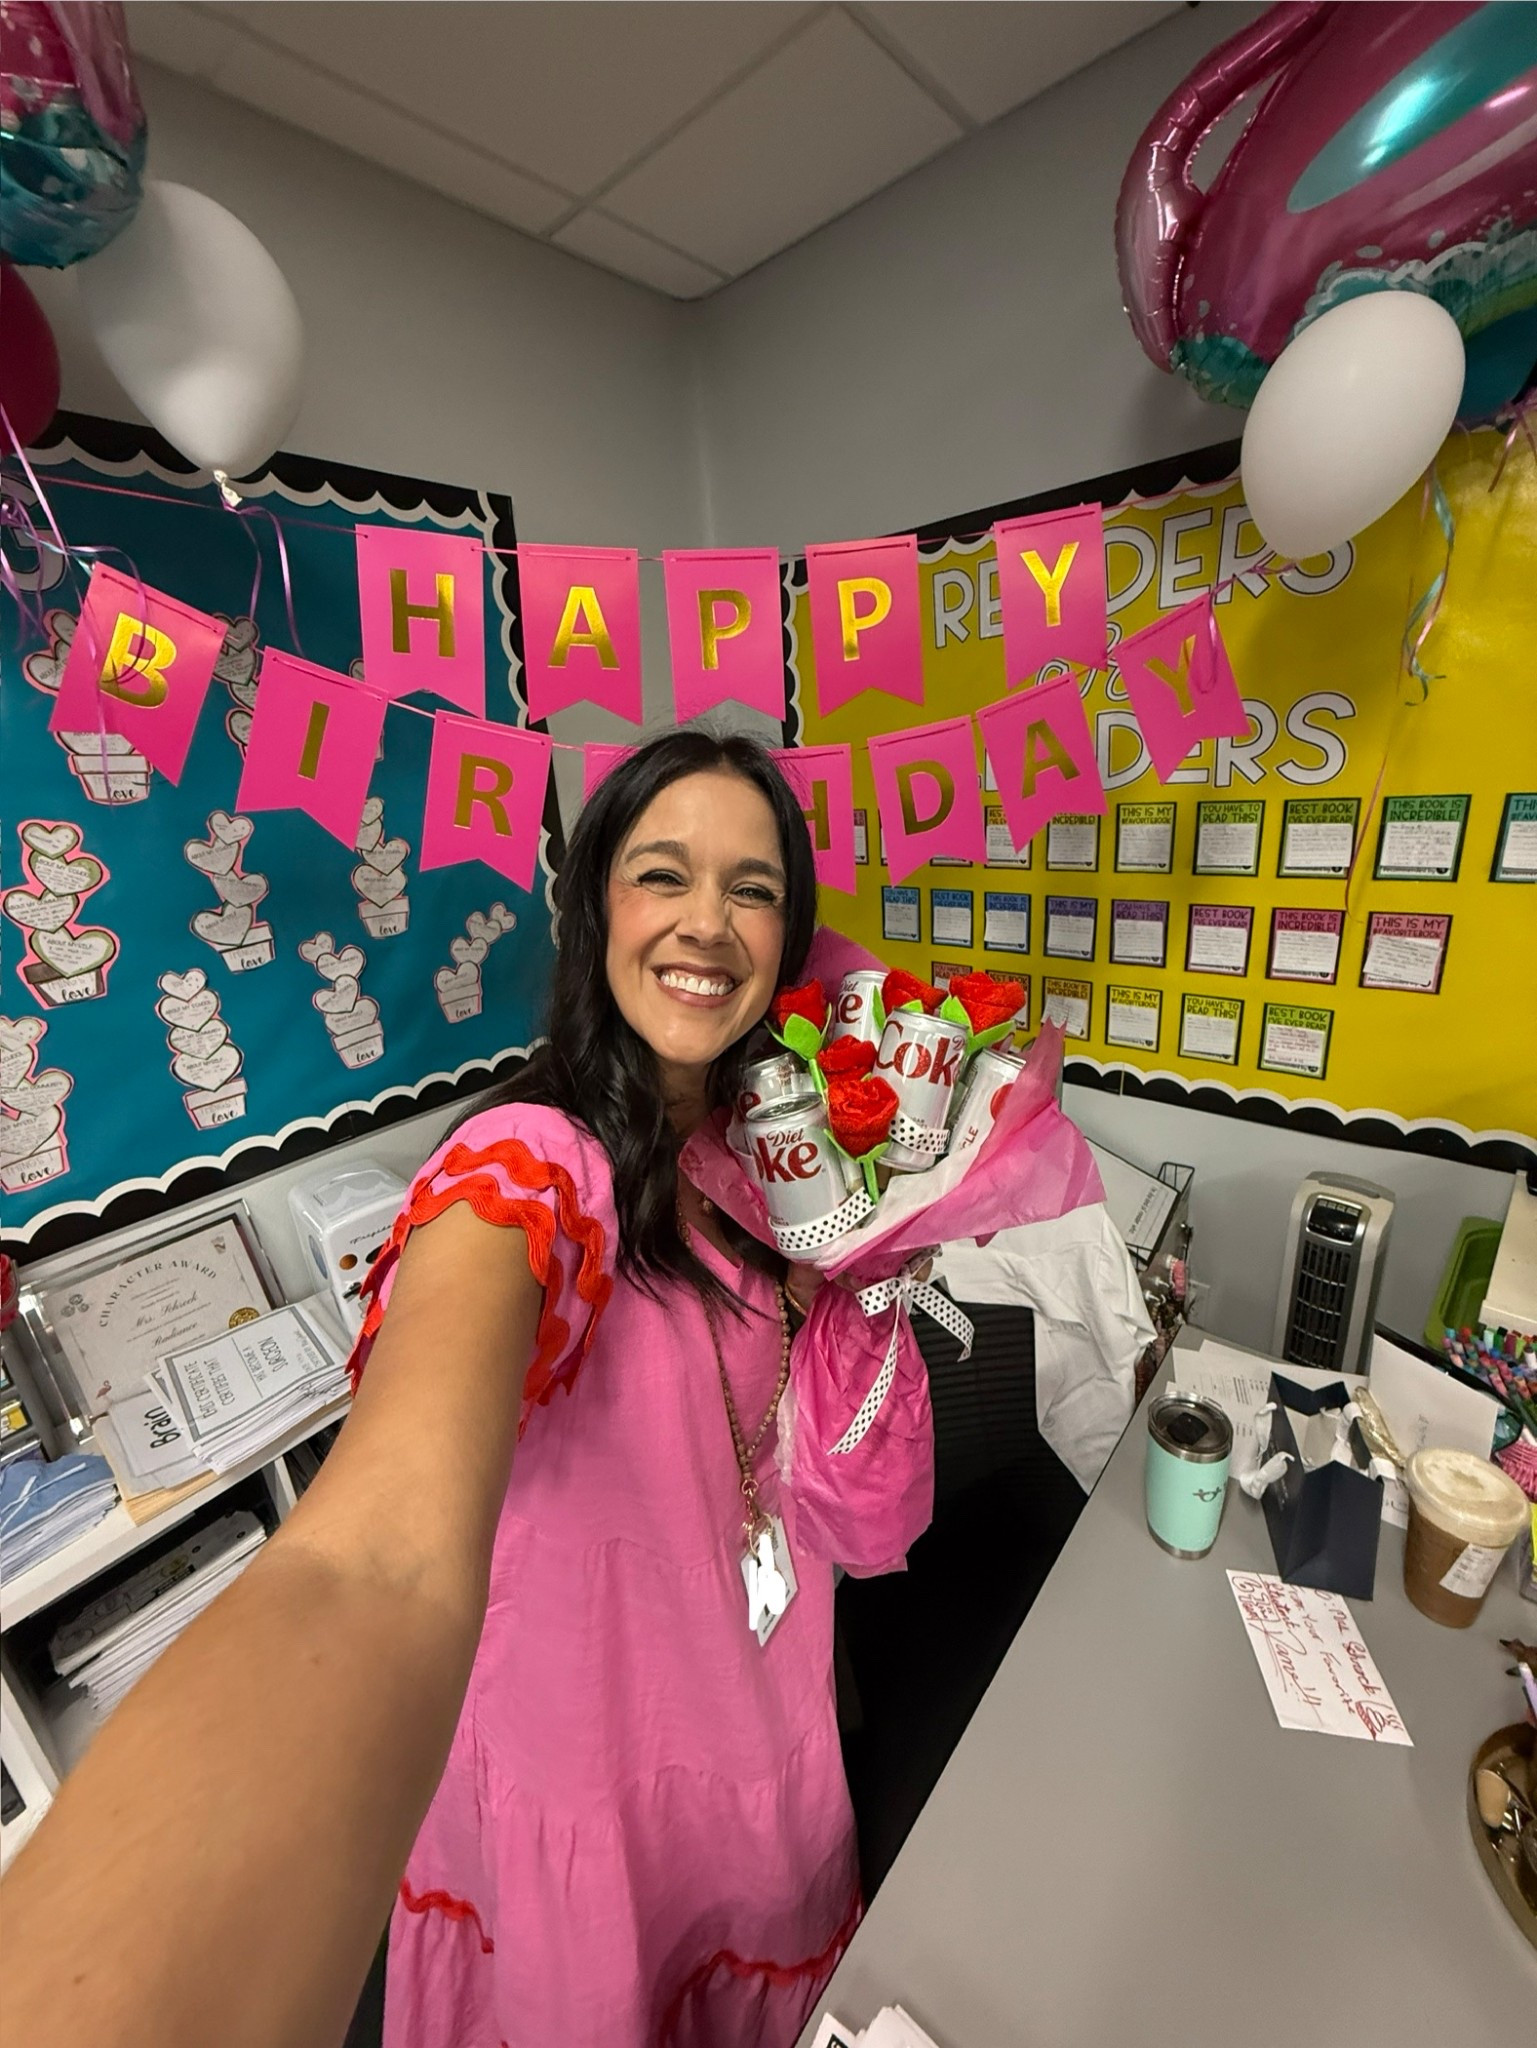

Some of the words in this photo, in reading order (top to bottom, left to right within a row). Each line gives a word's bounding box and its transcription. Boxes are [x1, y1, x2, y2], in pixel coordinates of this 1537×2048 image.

[389, 541, 1080, 671] HAPPY
[97, 612, 1197, 851] BIRHDAY
[1202, 804, 1222, 813] YOU
[1224, 804, 1244, 813] HAVE
[1246, 803, 1260, 812] TO
[1289, 804, 1318, 814] BEST
[1322, 803, 1354, 814] BOOK
[1392, 800, 1415, 809] THIS
[1418, 799, 1450, 809] BOOK
[1451, 799, 1463, 809] IS
[1122, 807, 1142, 817] THIS
[1145, 807, 1153, 816] IS
[1158, 807, 1172, 816] MY
[1202, 813, 1228, 823] READ
[1231, 812, 1258, 823] THIS!
[1390, 809, 1461, 821] INCREDIBLE!
[1194, 908, 1217, 918] BEST
[1222, 910, 1249, 919] BOOK
[1279, 911, 1298, 920] THIS
[1301, 912, 1326, 921] BOOK
[1328, 913, 1338, 922] IS
[1277, 920, 1336, 931] INCREDIBLE!
[1374, 916, 1402, 928] THIS
[1406, 918, 1419, 929] IS
[1423, 919, 1446, 930] MY
[379, 925, 400, 936] love
[240, 956, 265, 970] love
[61, 986, 95, 1001] love
[1112, 988, 1131, 999] THIS
[1133, 990, 1142, 1000] IS
[1145, 992, 1159, 1001] MY
[1187, 997, 1204, 1006] YOU
[1205, 999, 1225, 1008] HAVE
[1228, 1002, 1240, 1010] TO
[1186, 1005, 1209, 1015] READ
[1213, 1008, 1238, 1019] THIS!
[1269, 1007, 1296, 1018] BEST
[1299, 1010, 1328, 1022] BOOK
[1284, 1019, 1304, 1027] EVER
[356, 1049, 377, 1063] love
[876, 1020, 962, 1087] Cok
[211, 1110, 238, 1124] love
[766, 1128, 804, 1147] Diet
[753, 1136, 822, 1183] ke
[20, 1166, 53, 1185] love
[99, 1261, 163, 1328] CHARACTER
[171, 1260, 218, 1280] AWARD
[244, 1350, 261, 1372] BECOME
[259, 1336, 288, 1372] SURGEON
[203, 1357, 222, 1375] THAT
[184, 1361, 211, 1403] CERTIFICATE
[212, 1373, 236, 1406] CERTIFIES
[143, 1405, 182, 1450] Brain
[1301, 1613, 1323, 1644] Your
[1320, 1652, 1356, 1715] Favorite
